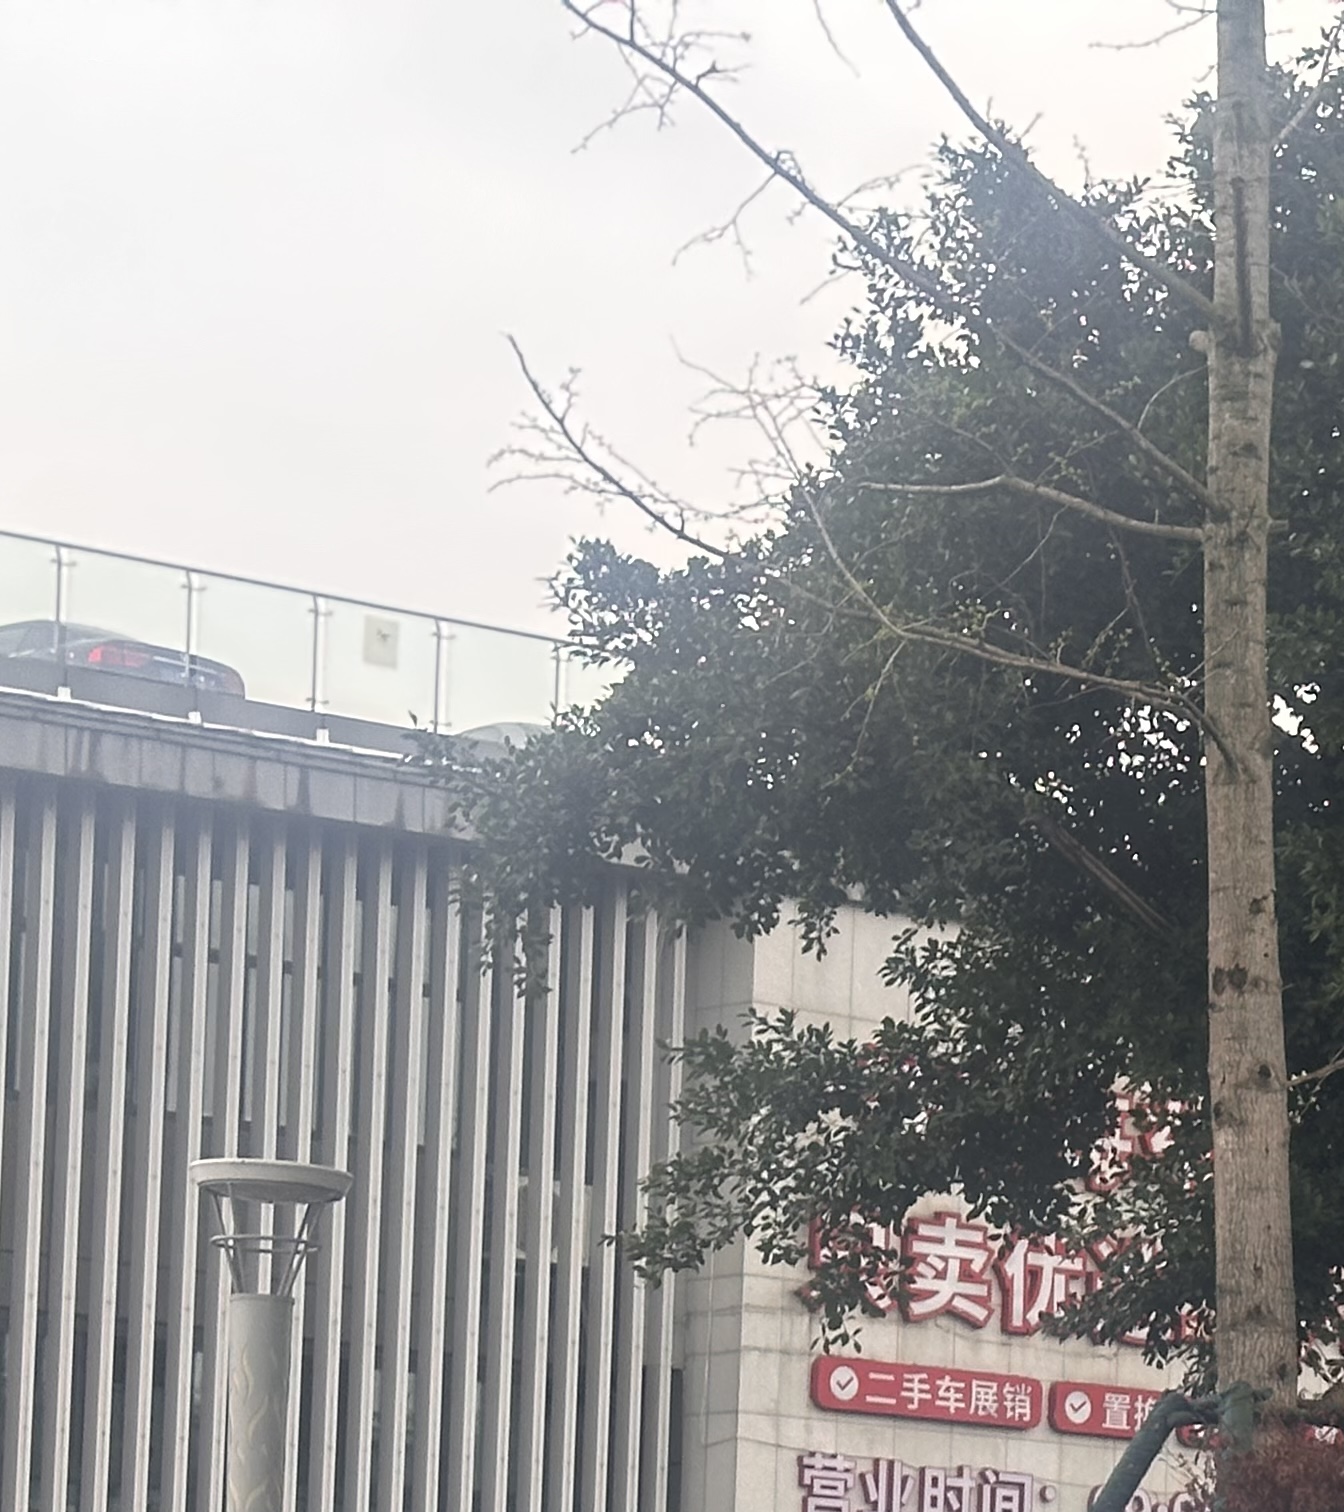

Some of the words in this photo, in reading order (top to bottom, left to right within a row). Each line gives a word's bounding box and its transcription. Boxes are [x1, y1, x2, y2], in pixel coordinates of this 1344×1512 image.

[865, 1371, 1032, 1421] 二手车展销
